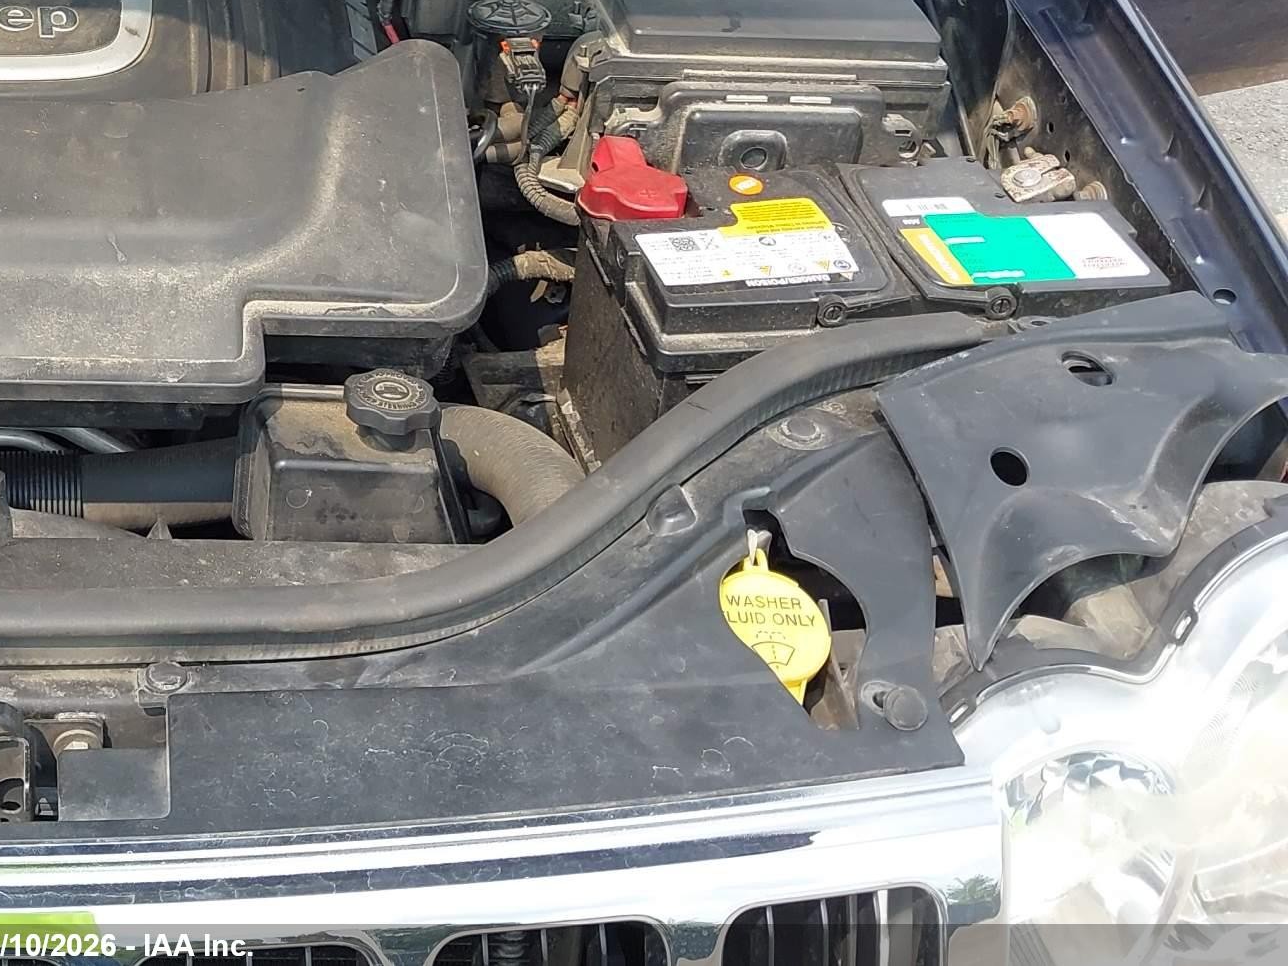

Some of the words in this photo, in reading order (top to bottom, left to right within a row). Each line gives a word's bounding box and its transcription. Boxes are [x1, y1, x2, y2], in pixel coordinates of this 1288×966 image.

[726, 594, 802, 610] WASHER
[723, 610, 766, 625] LUID
[772, 612, 816, 627] ONLY
